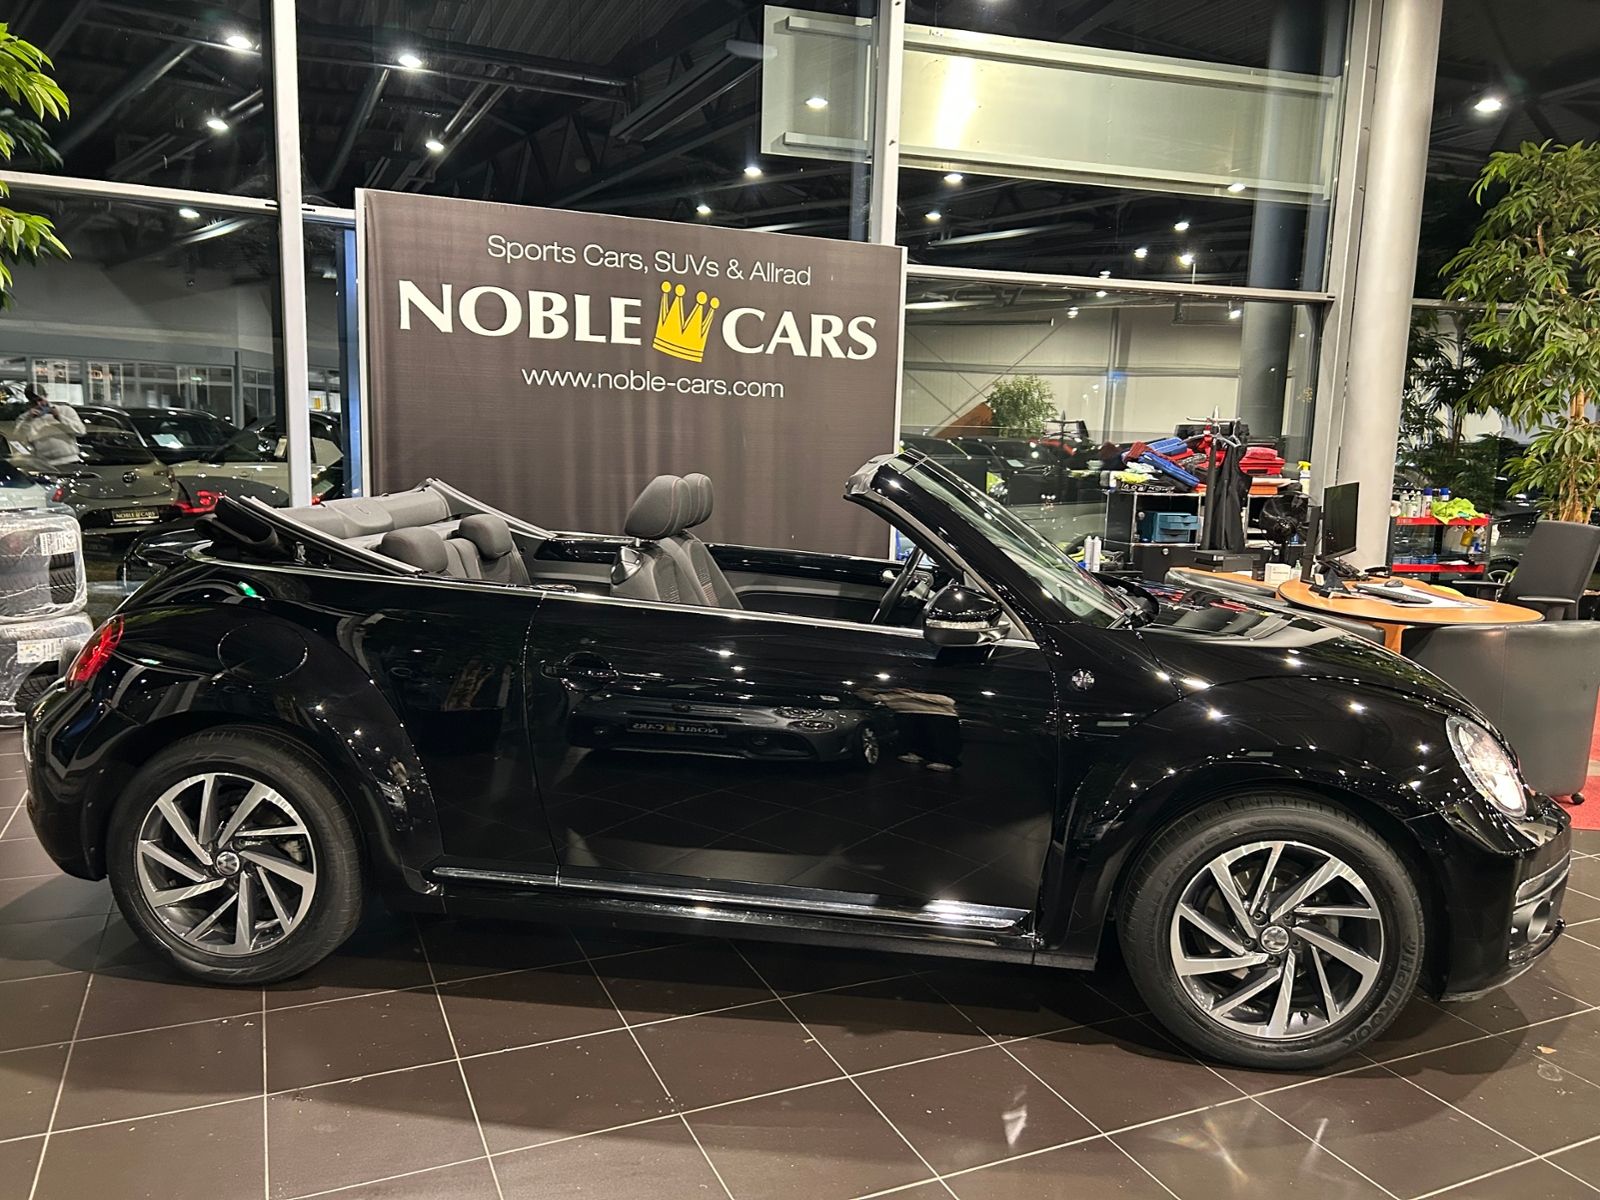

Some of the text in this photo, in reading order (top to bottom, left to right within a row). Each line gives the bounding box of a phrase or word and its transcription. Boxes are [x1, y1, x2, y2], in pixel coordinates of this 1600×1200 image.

[487, 234, 811, 286] Sports Cars, SUVs & Allrad
[398, 280, 878, 360] NOBLE CARS
[521, 368, 785, 398] www.noble-cars.com
